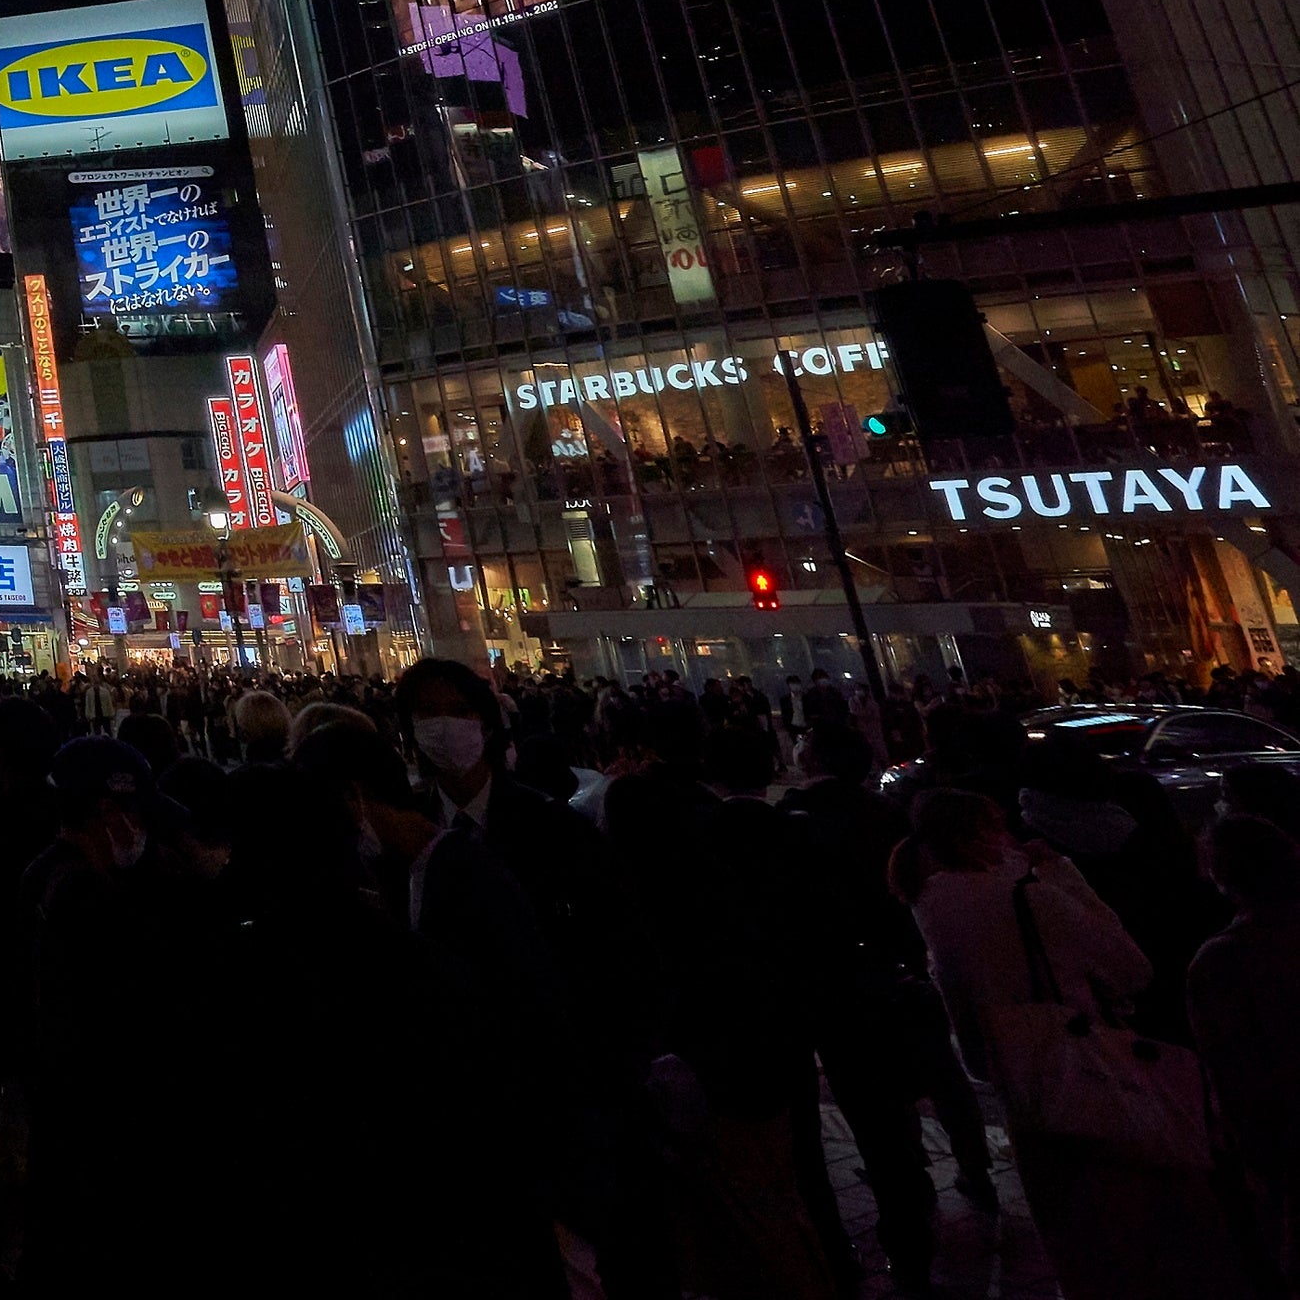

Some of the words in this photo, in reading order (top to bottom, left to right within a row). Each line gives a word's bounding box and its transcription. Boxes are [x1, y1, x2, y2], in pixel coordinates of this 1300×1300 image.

[475, 21, 490, 33] ON
[7, 51, 194, 102] IKEA
[73, 168, 190, 180] #プロジェクトワールドチャンピオン
[80, 201, 218, 243] エゴイストでなければ
[95, 183, 202, 221] 世界一の
[101, 230, 210, 269] 世界一の
[85, 252, 230, 301] ストライカー
[109, 284, 211, 314] にはなれない。
[27, 278, 53, 380] クスリのことなら
[517, 356, 747, 411] STARBUCKS
[773, 341, 891, 379] COFF
[234, 369, 264, 457] カラオケ
[929, 464, 1271, 521] TSUTAYA
[59, 521, 79, 551] 焼肉
